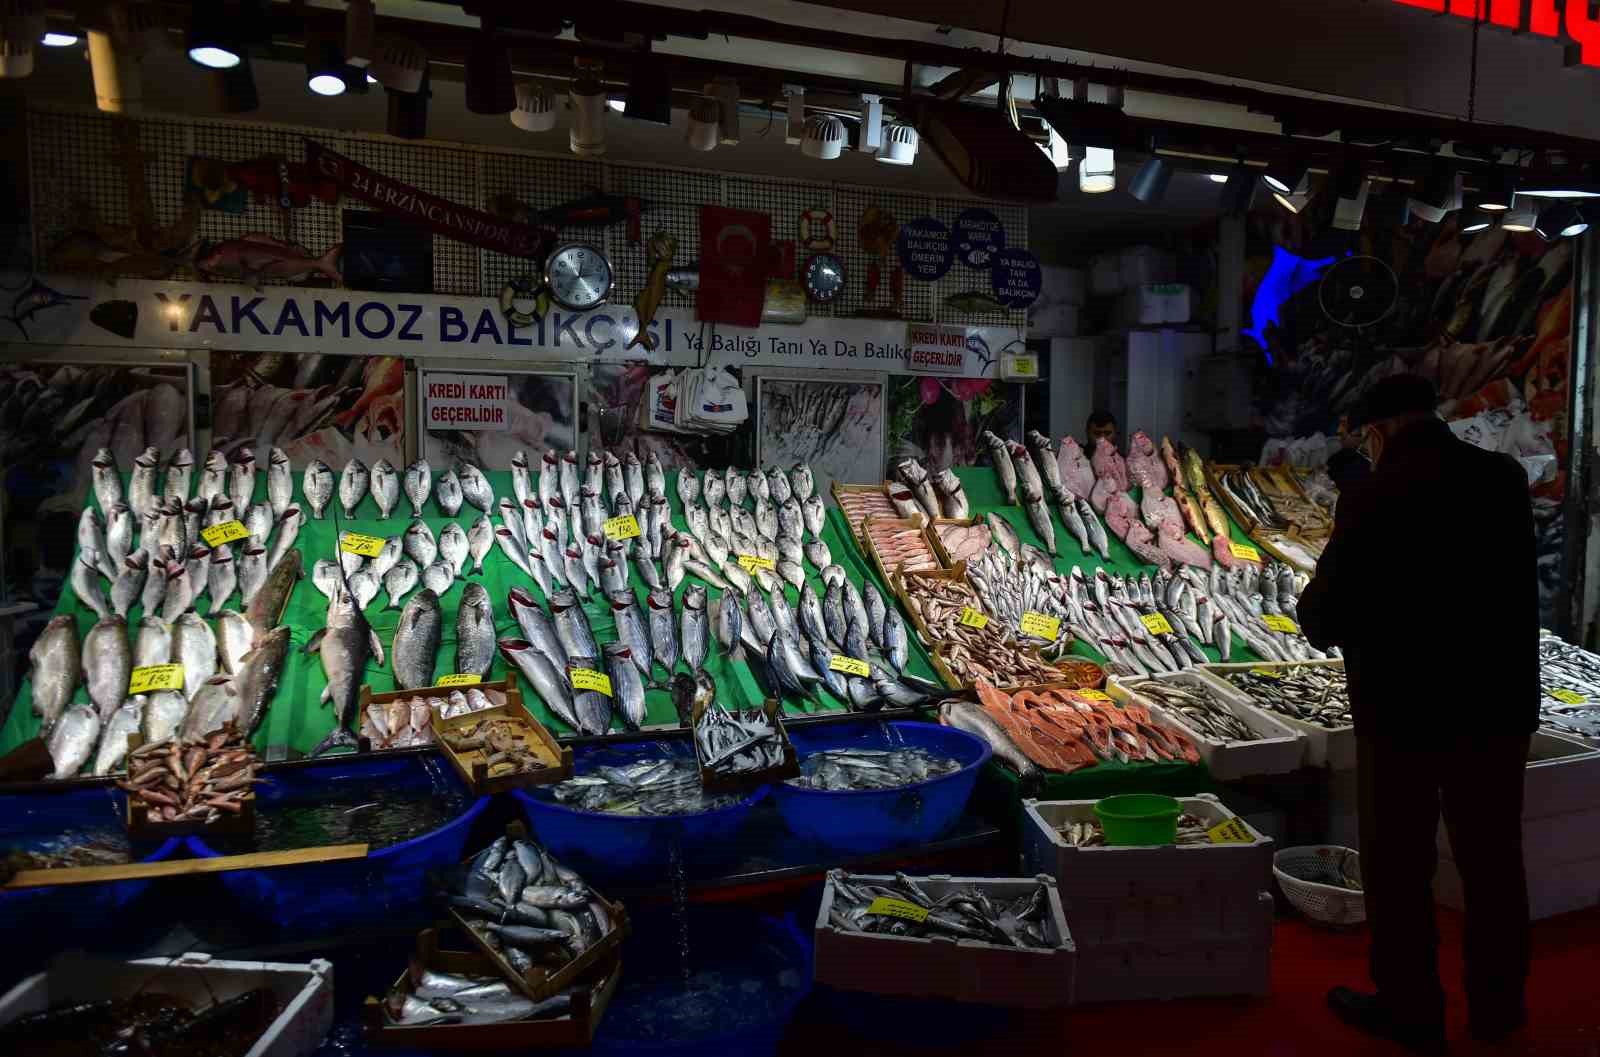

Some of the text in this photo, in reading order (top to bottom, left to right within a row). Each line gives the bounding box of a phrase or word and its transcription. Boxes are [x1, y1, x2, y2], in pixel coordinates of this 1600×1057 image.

[351, 171, 369, 193] 24
[907, 228, 950, 240] YAKAMOZ
[154, 292, 424, 340] YAKAMOZ
[684, 332, 704, 350] Ya
[711, 334, 760, 357] Balığı
[768, 336, 803, 355] Tanı
[809, 339, 828, 356] Ya
[834, 340, 857, 357] Da
[428, 381, 506, 401] KREDİ KARTI
[431, 404, 504, 426] GEÇERLİDİR
